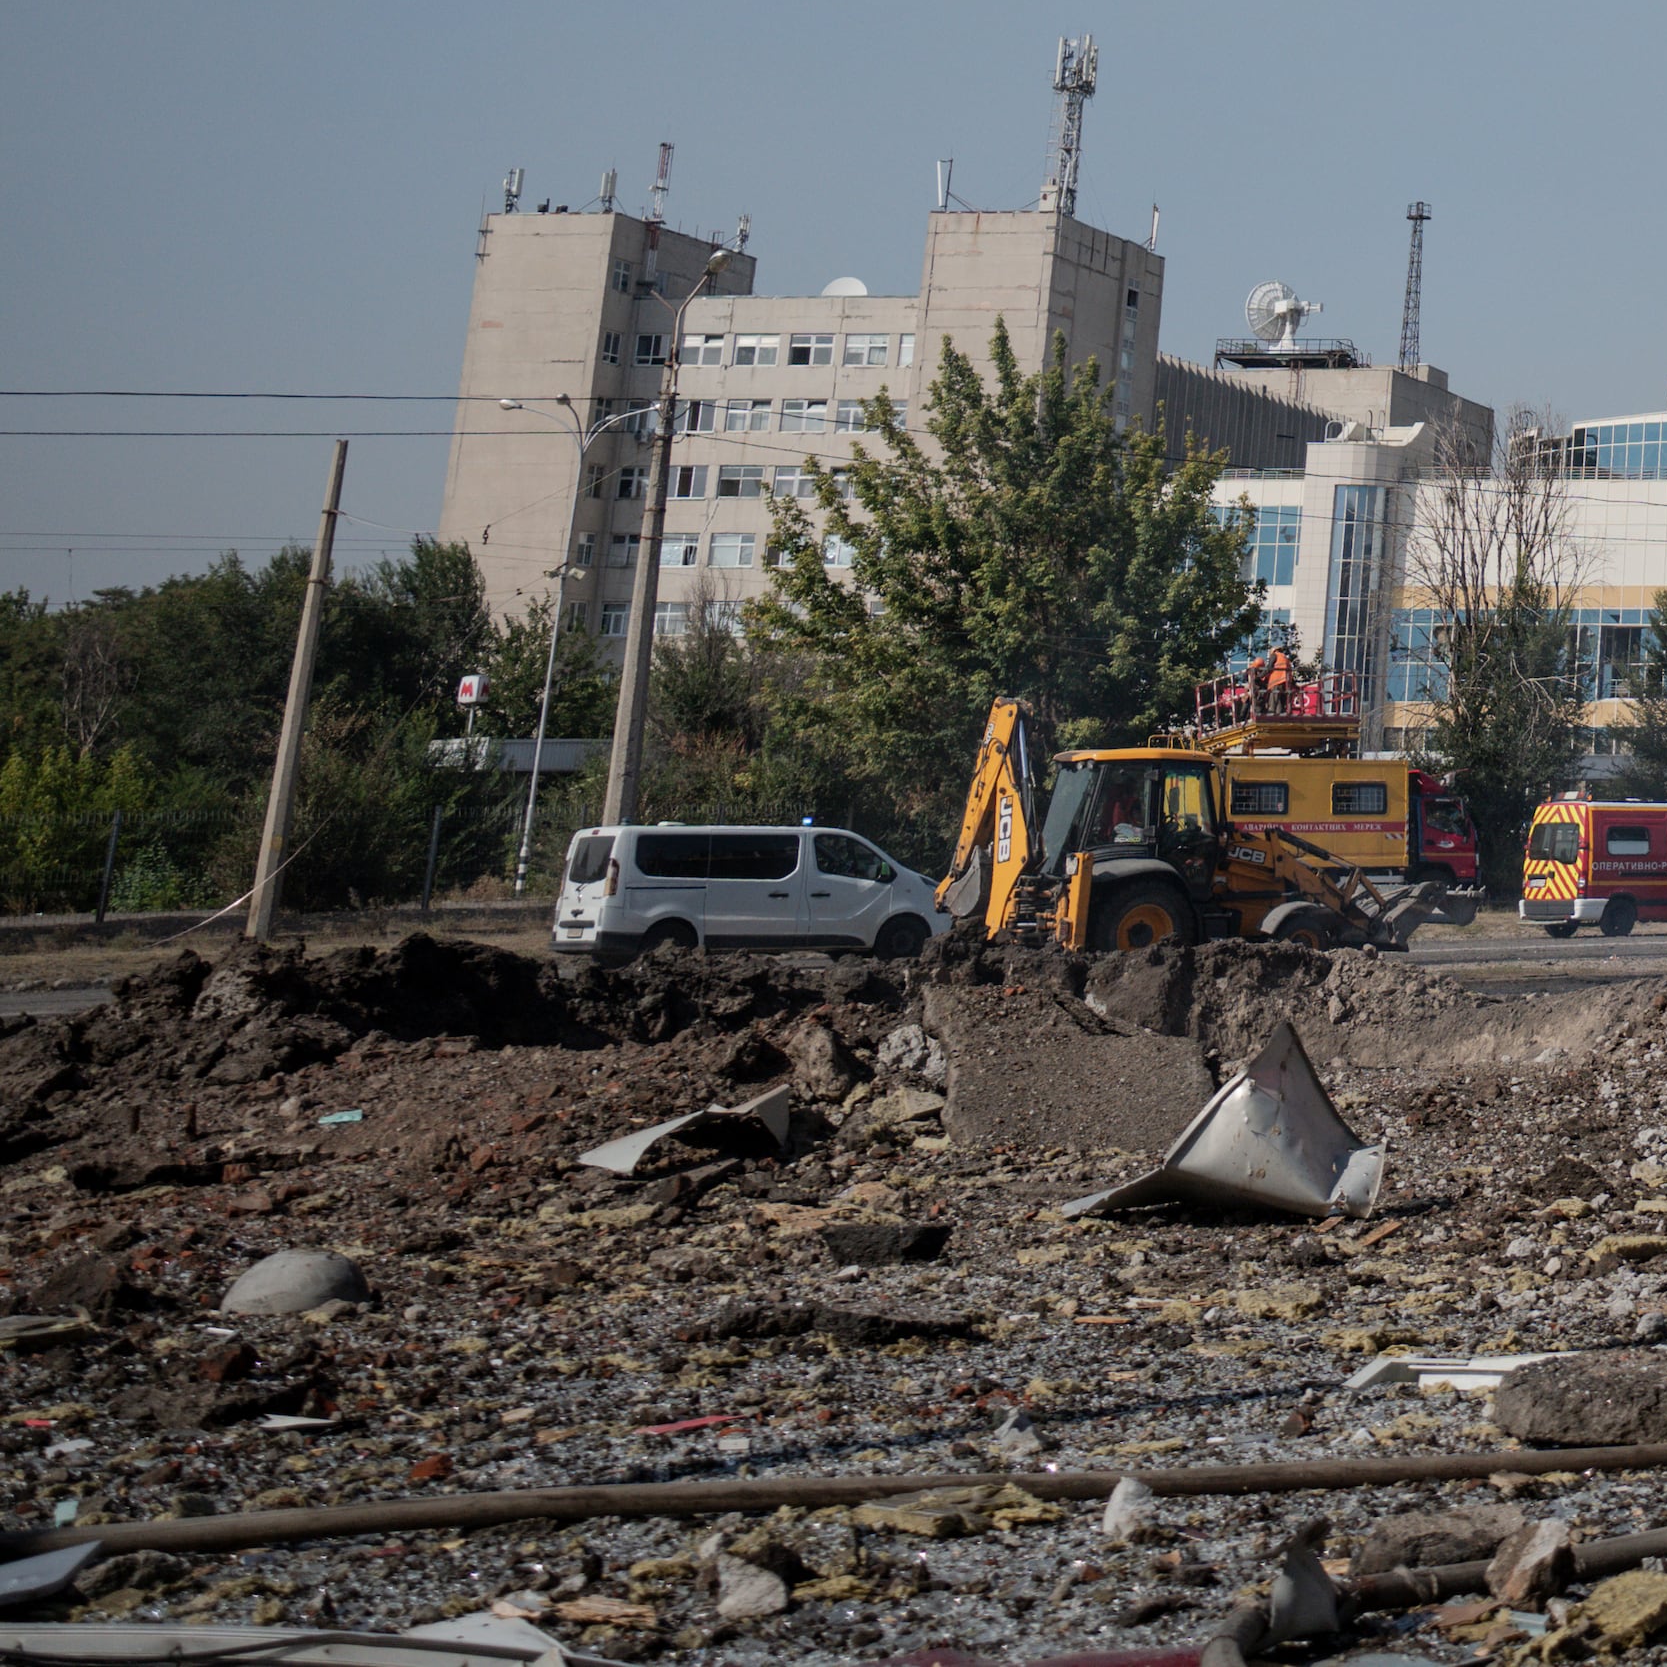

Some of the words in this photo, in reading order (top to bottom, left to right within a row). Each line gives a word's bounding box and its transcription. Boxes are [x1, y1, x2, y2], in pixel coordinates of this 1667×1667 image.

[997, 796, 1013, 863] JCB
[1291, 823, 1347, 831] КОНТАКТНИХ
[1352, 823, 1383, 831] МЕРЕЖ
[1228, 846, 1266, 864] JCB
